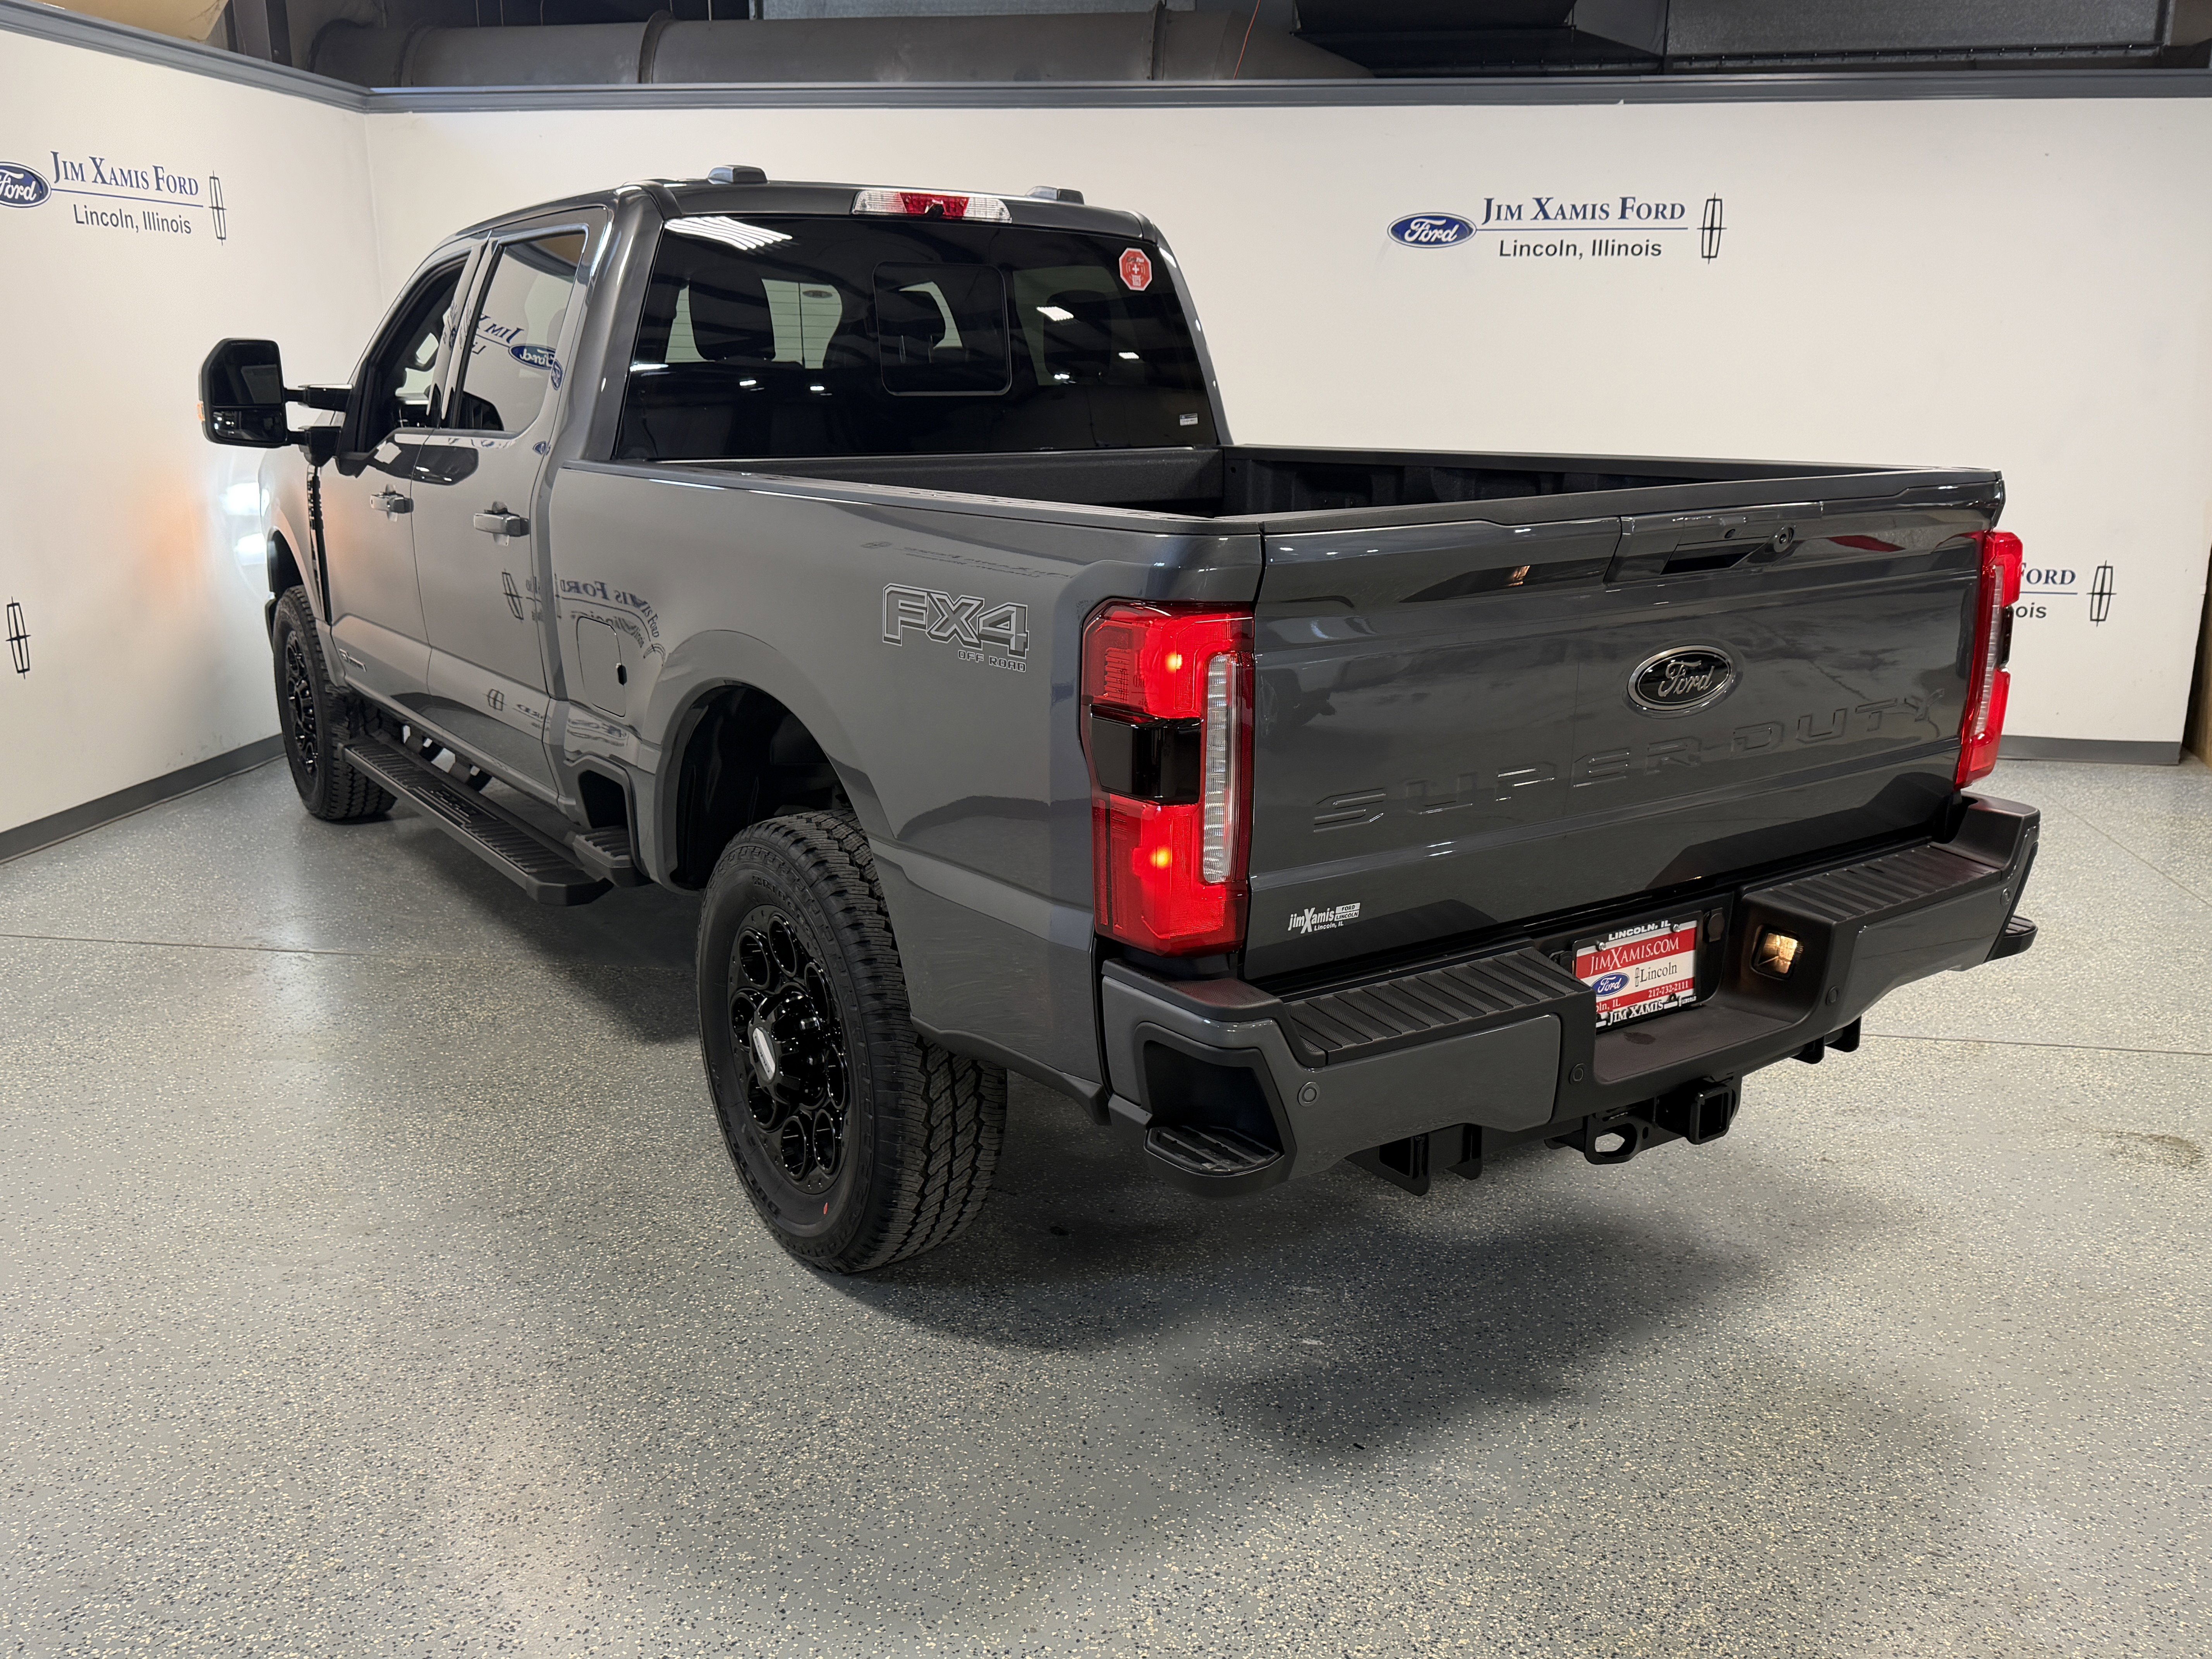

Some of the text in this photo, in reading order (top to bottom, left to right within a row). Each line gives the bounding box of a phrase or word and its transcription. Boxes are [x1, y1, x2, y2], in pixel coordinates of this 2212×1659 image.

[0, 169, 36, 201] Ford
[50, 151, 199, 195] JIM XAMIS FORD
[73, 204, 192, 234] Lincoln, Illinois
[1482, 197, 1686, 225] JIM XAMIS FORD
[1405, 218, 1457, 243] Ford
[1499, 239, 1662, 259] Lincoln, Illinois
[883, 583, 1029, 659] FX4
[958, 649, 1026, 672] OFF ROAD
[1658, 660, 1715, 697] Ford
[1314, 688, 1945, 832] SUPER DUTY
[1288, 907, 1334, 934] jimXamis
[1314, 922, 1336, 931] Lincoln,
[1336, 911, 1358, 920] LINCOLN
[1608, 923, 1659, 941] LINCOLN,
[1590, 937, 1679, 975] JIMXAMIS.COM
[1597, 975, 1621, 993] Ford
[1640, 962, 1677, 982] Lincoln
[1648, 981, 1689, 998] 217-732-2111
[1596, 999, 1621, 1012] oln, IL
[1608, 1001, 1663, 1025] JIM XAMIS
